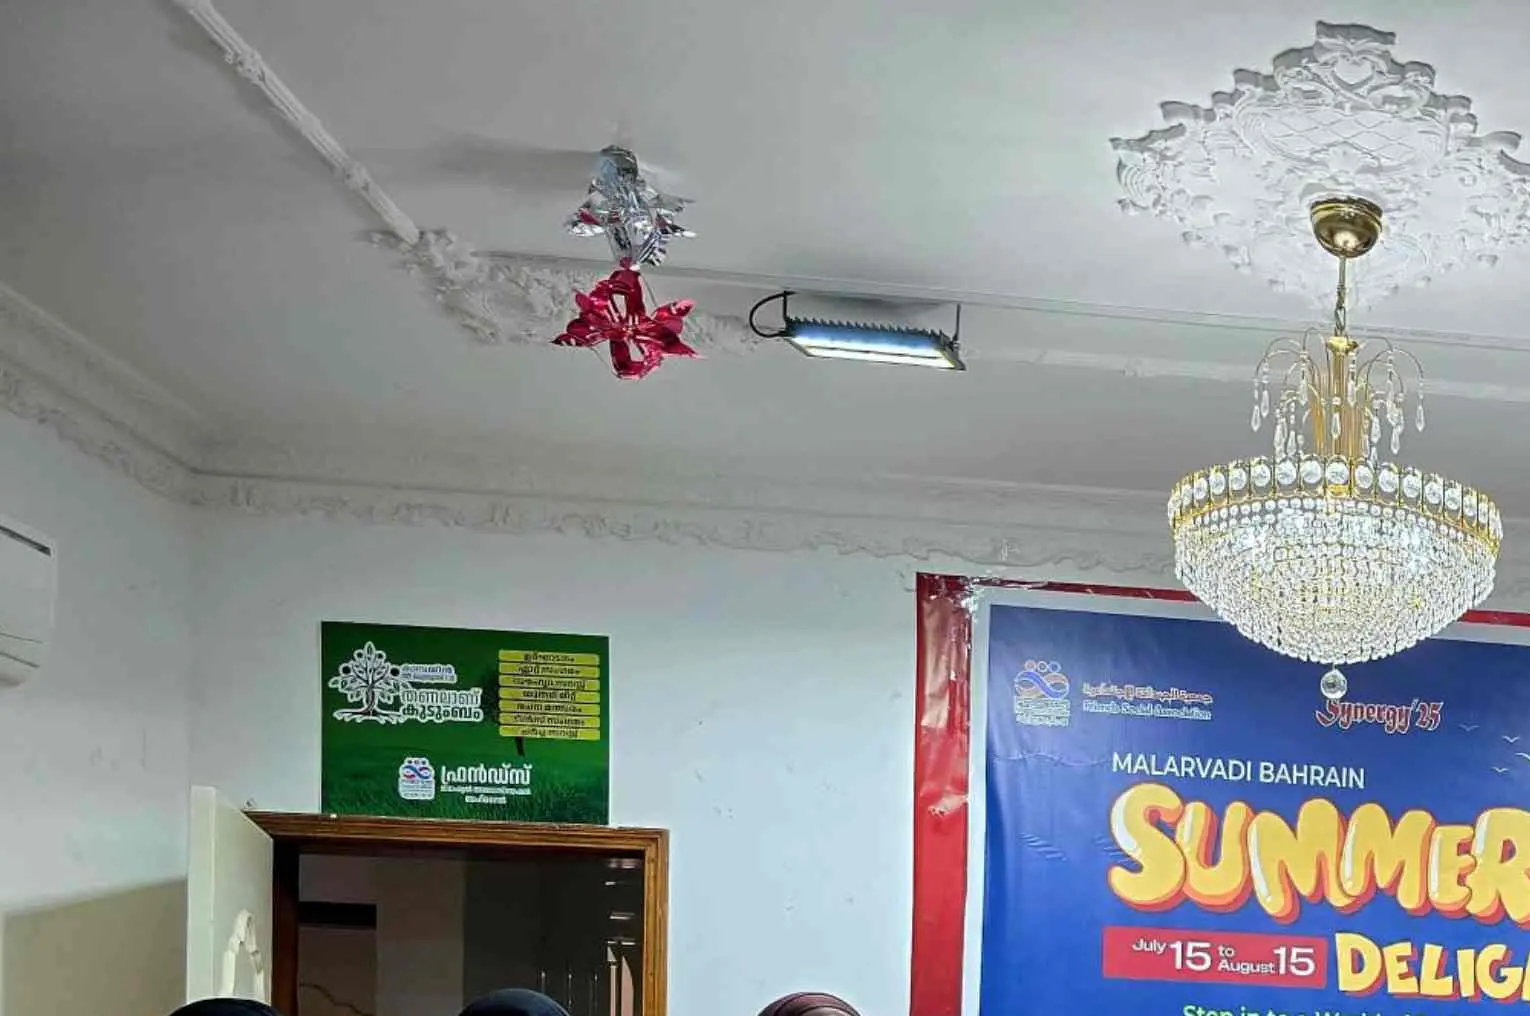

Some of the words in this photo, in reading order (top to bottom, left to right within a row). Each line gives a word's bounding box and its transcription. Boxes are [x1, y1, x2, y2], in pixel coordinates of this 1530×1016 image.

[1112, 751, 1252, 782] MALARVADI
[1259, 761, 1365, 790] BAHRAIN
[1132, 938, 1166, 954] July
[1170, 940, 1212, 972] 15
[1217, 944, 1236, 958] to
[1217, 959, 1275, 975] August
[1273, 946, 1316, 977] 15
